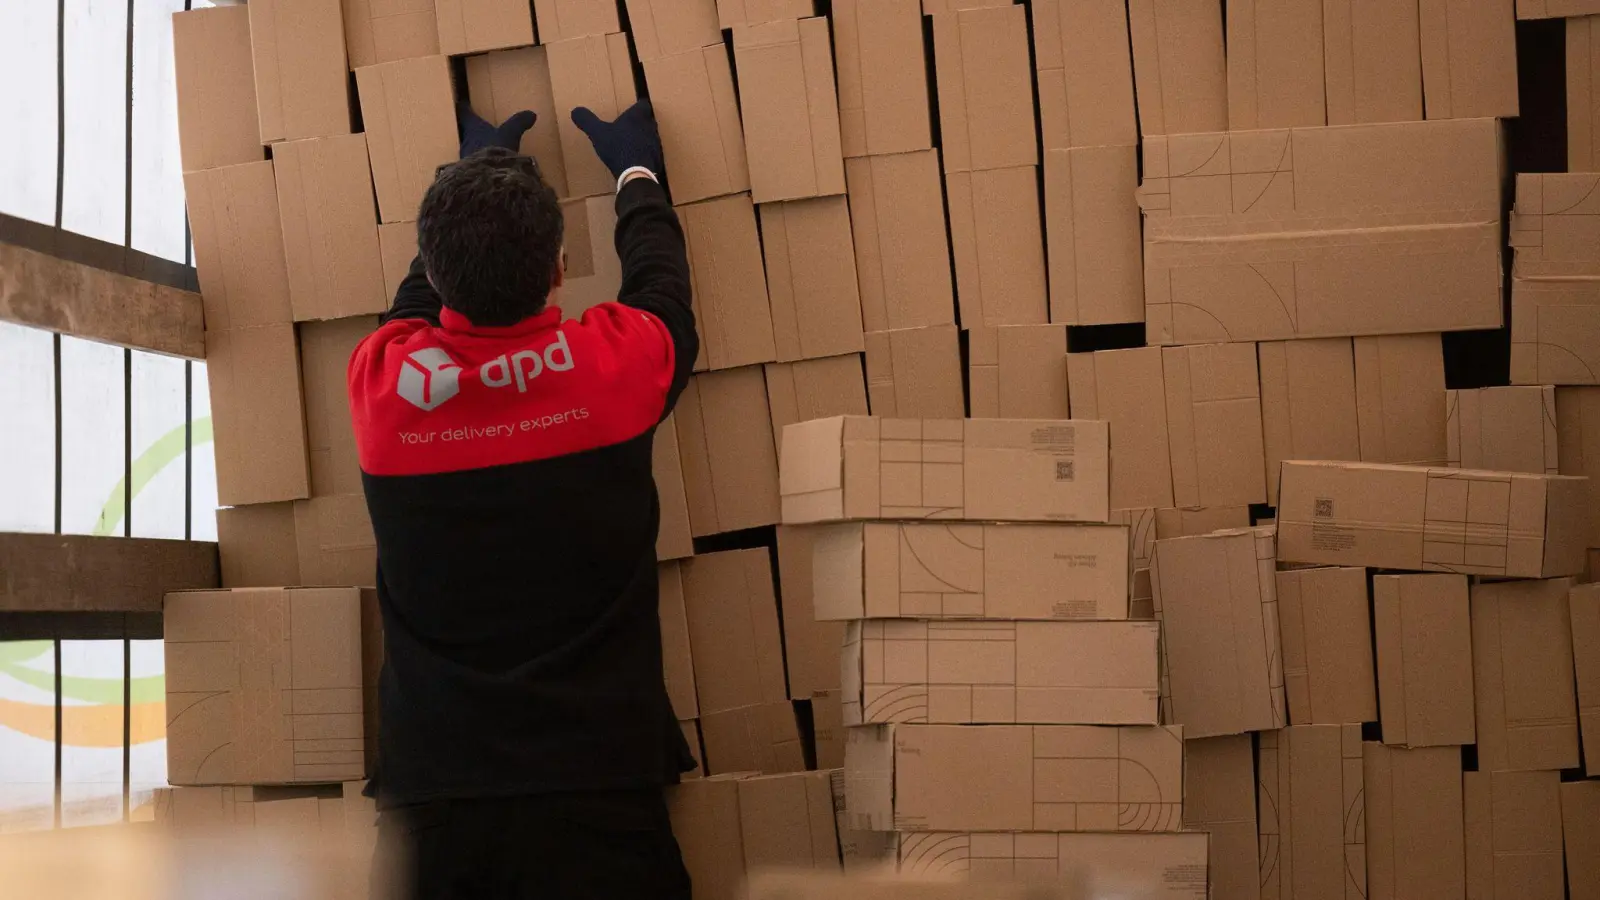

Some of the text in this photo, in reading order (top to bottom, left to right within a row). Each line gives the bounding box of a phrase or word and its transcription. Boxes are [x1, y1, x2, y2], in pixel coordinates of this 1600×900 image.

[398, 407, 590, 445] Your delivery experts
